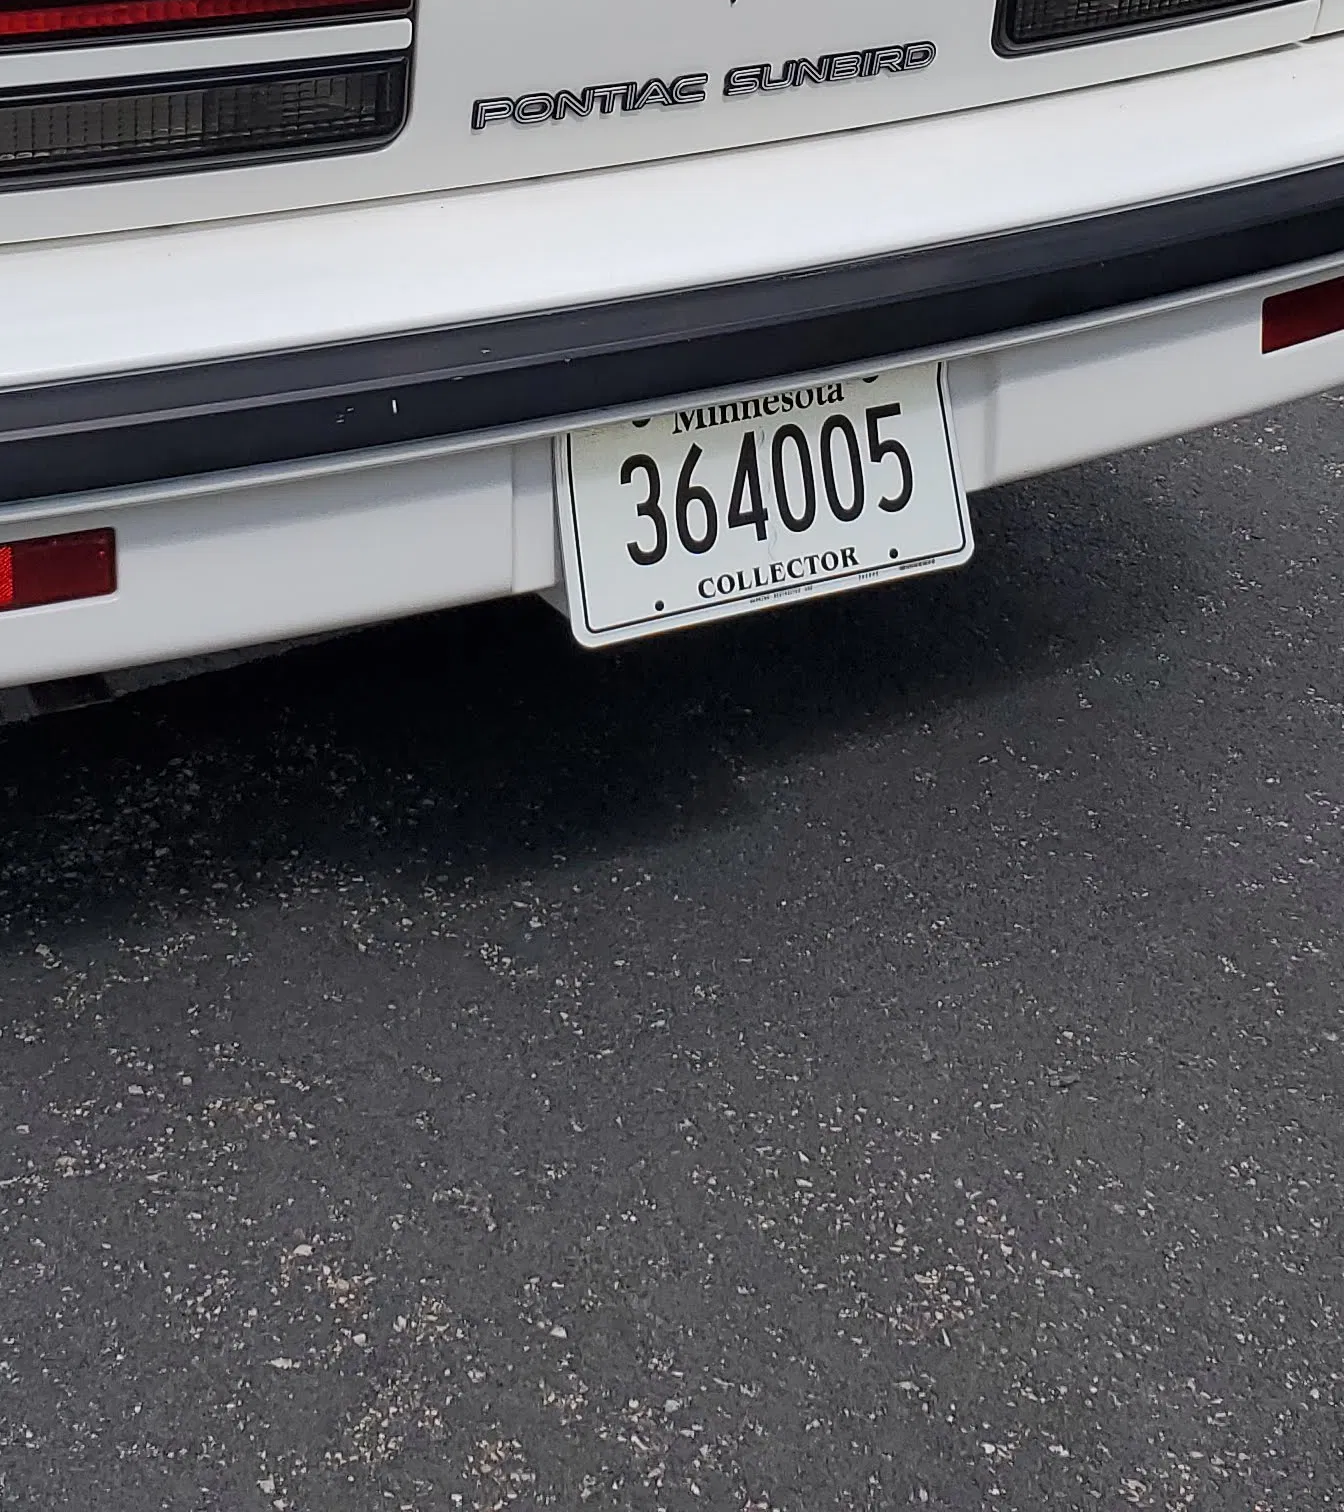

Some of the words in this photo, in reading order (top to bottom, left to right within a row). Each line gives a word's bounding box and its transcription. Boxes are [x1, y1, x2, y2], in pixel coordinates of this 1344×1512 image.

[471, 73, 709, 130] PONTIAC
[723, 40, 937, 97] SUNBIRD
[672, 382, 845, 435] Minnesota
[620, 402, 913, 566] 364005
[697, 546, 860, 600] COLLECTOR
